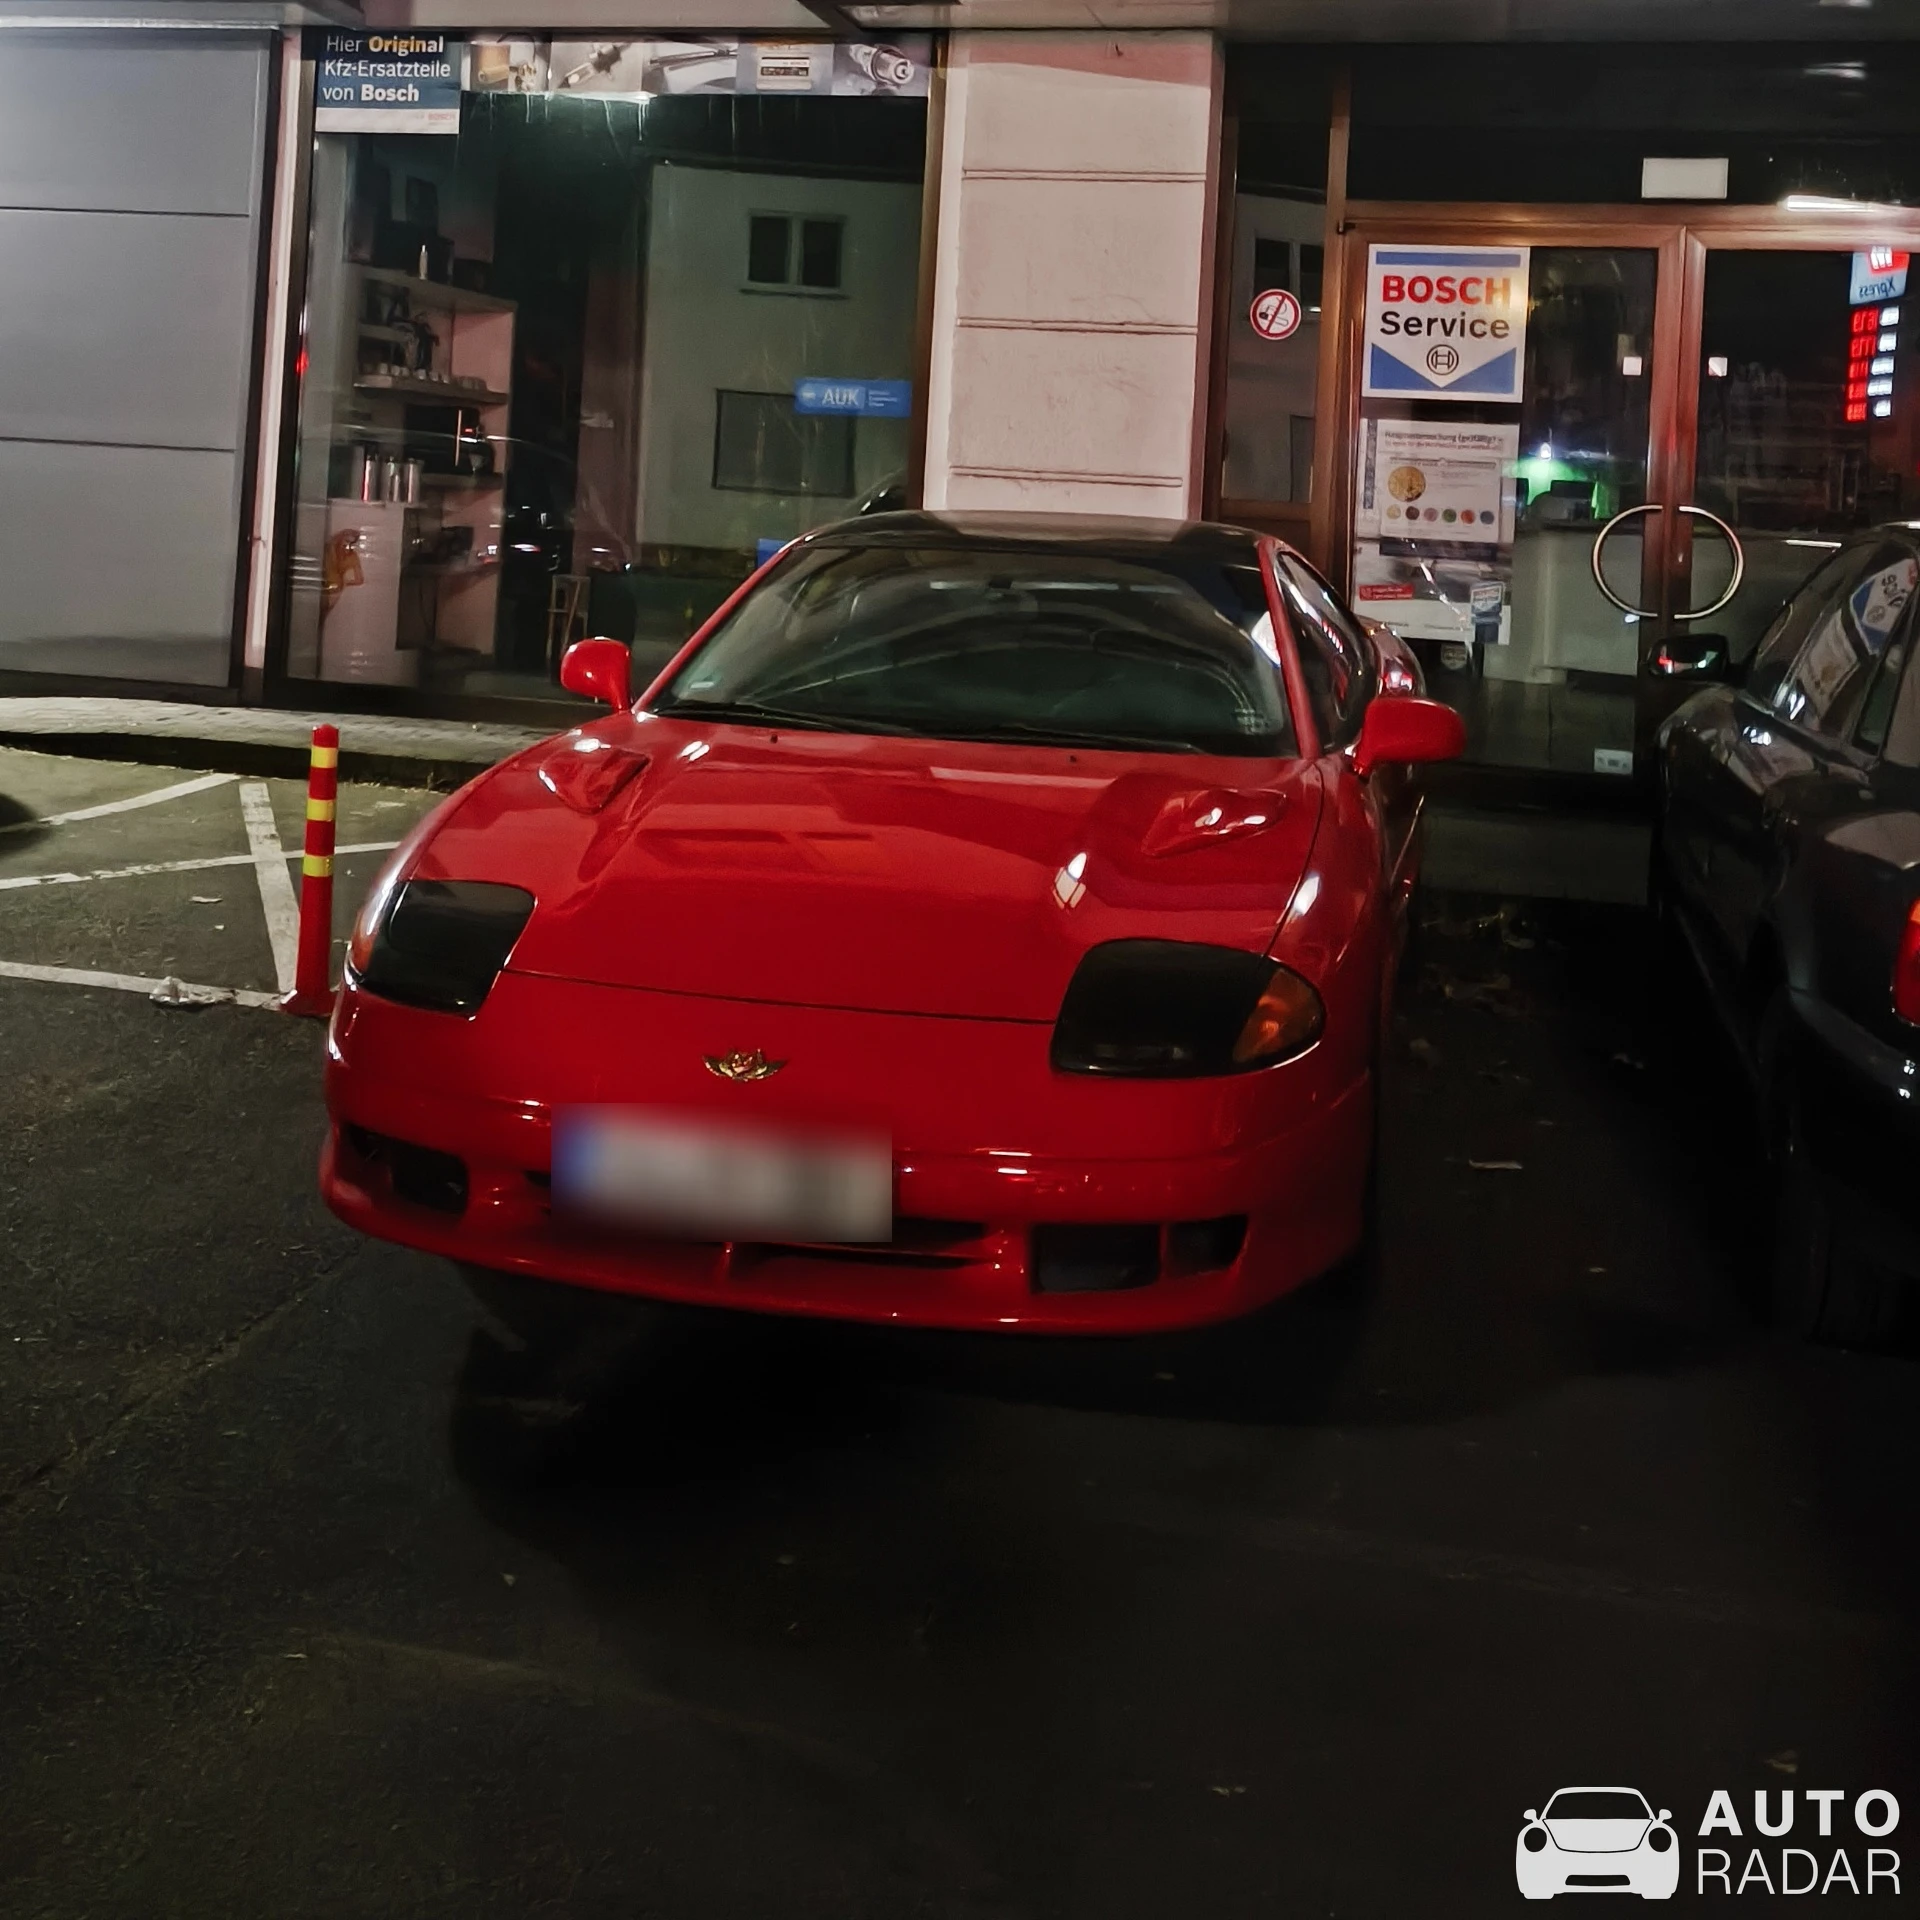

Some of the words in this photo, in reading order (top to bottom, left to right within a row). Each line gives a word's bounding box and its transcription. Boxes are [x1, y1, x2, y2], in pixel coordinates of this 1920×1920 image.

[326, 35, 363, 53] Hier
[368, 35, 444, 57] Original
[324, 59, 451, 78] Kfz-Ersatzteile
[322, 86, 354, 101] von
[360, 83, 420, 102] Bosch
[1381, 274, 1512, 306] BOSCH
[1379, 310, 1511, 339] Service
[821, 386, 860, 406] AUK
